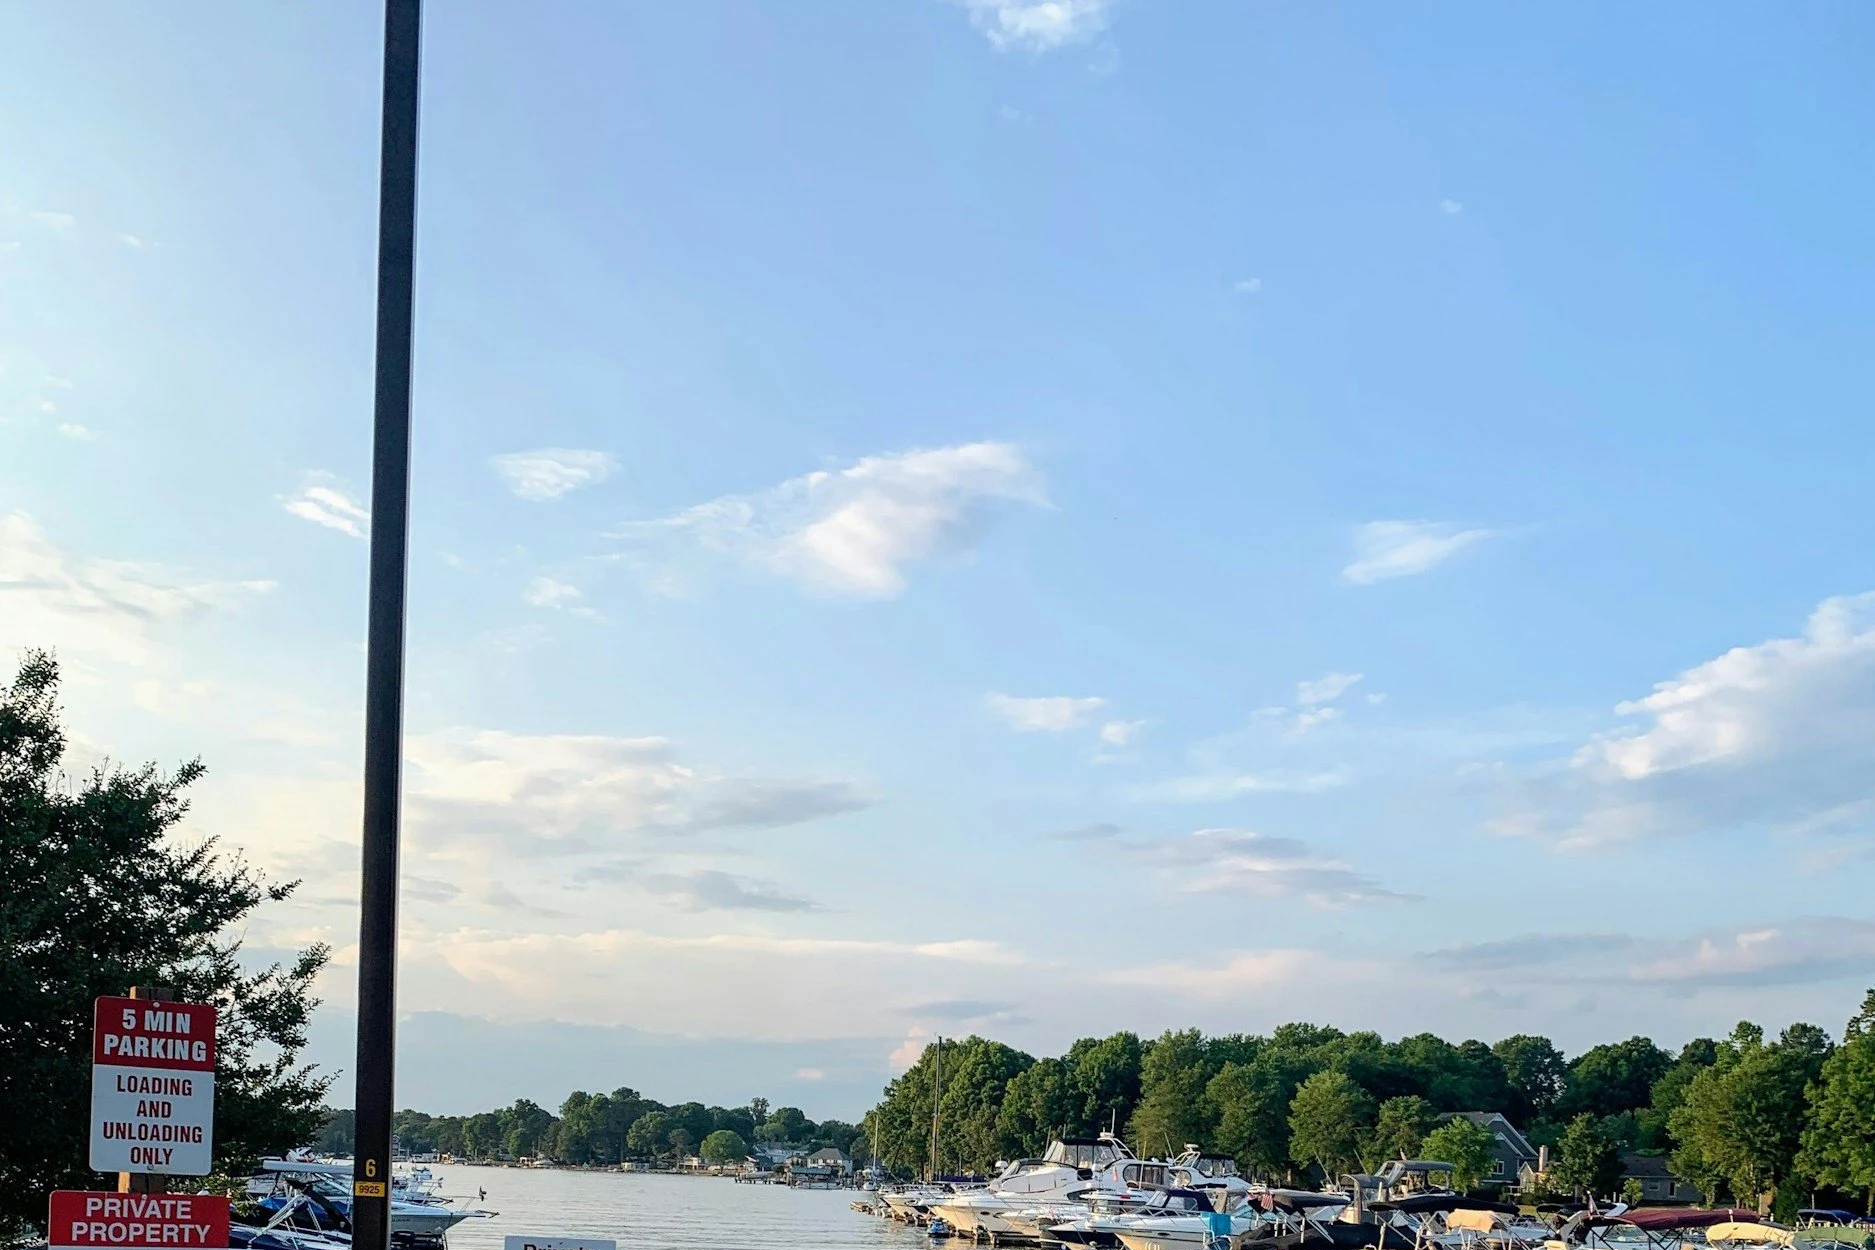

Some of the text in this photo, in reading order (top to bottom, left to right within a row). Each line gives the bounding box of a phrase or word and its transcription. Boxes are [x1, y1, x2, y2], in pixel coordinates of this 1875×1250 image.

[122, 1008, 191, 1034] 5 MIN
[103, 1033, 207, 1062] PARKING
[116, 1074, 193, 1097] LOADING
[136, 1099, 172, 1118] AND
[103, 1121, 203, 1143] UNLOADING
[130, 1146, 174, 1165] ONLY
[365, 1158, 376, 1178] 6
[358, 1184, 380, 1194] 9925
[86, 1197, 192, 1220] PRIVATE
[71, 1222, 211, 1244] PROPERTY
